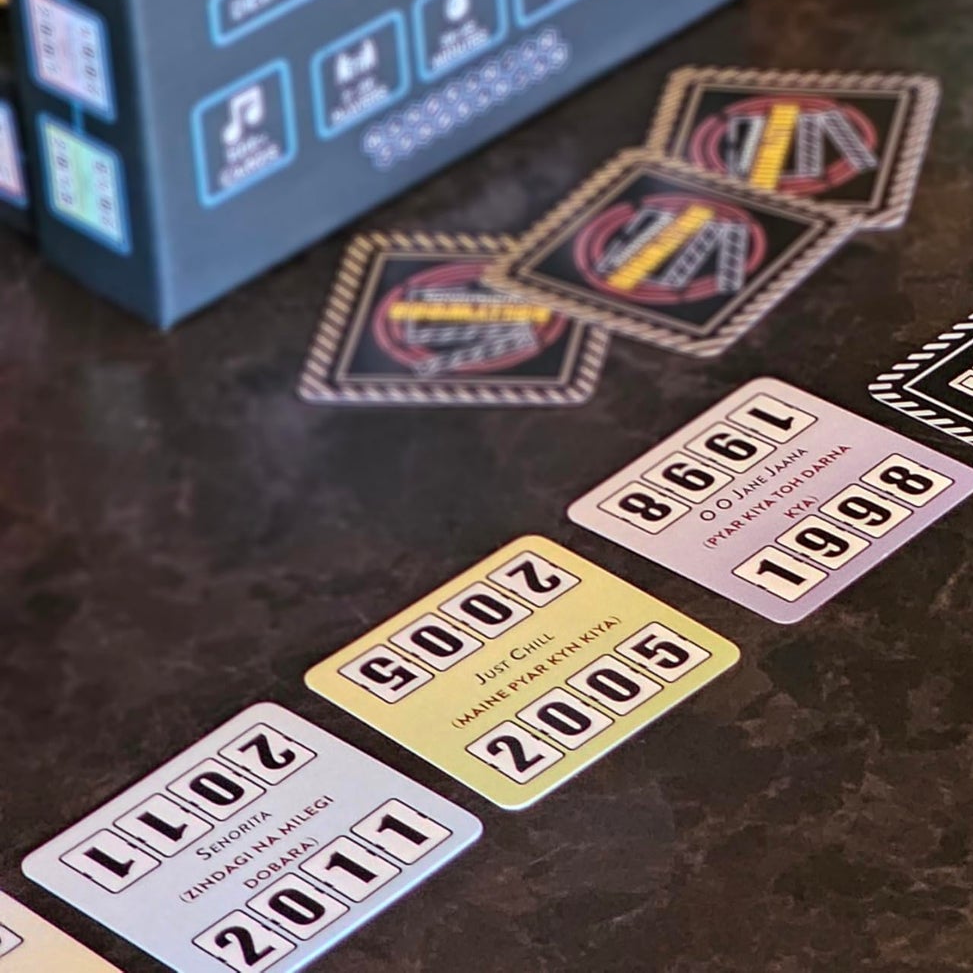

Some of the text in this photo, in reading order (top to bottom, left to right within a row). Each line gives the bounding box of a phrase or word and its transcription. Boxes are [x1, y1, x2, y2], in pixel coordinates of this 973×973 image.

[617, 406, 795, 523] 1998
[699, 447, 809, 522] O O JANE JAANA
[702, 444, 853, 550] (PYAR KIYA TOH DARNA
[783, 494, 820, 520] KYA)
[755, 464, 935, 587] 1998
[358, 559, 562, 693] 2005
[451, 615, 623, 730] (MAINE PYAR KYN KIYA)
[474, 632, 556, 686] JUST CHILL
[485, 633, 691, 774] 2005
[82, 732, 297, 879] 2011
[178, 794, 335, 904] (ZINDAGI NA MILEGI
[195, 810, 274, 862] SENORITA
[213, 813, 430, 968] 2011
[243, 836, 320, 891] DOBARA)
